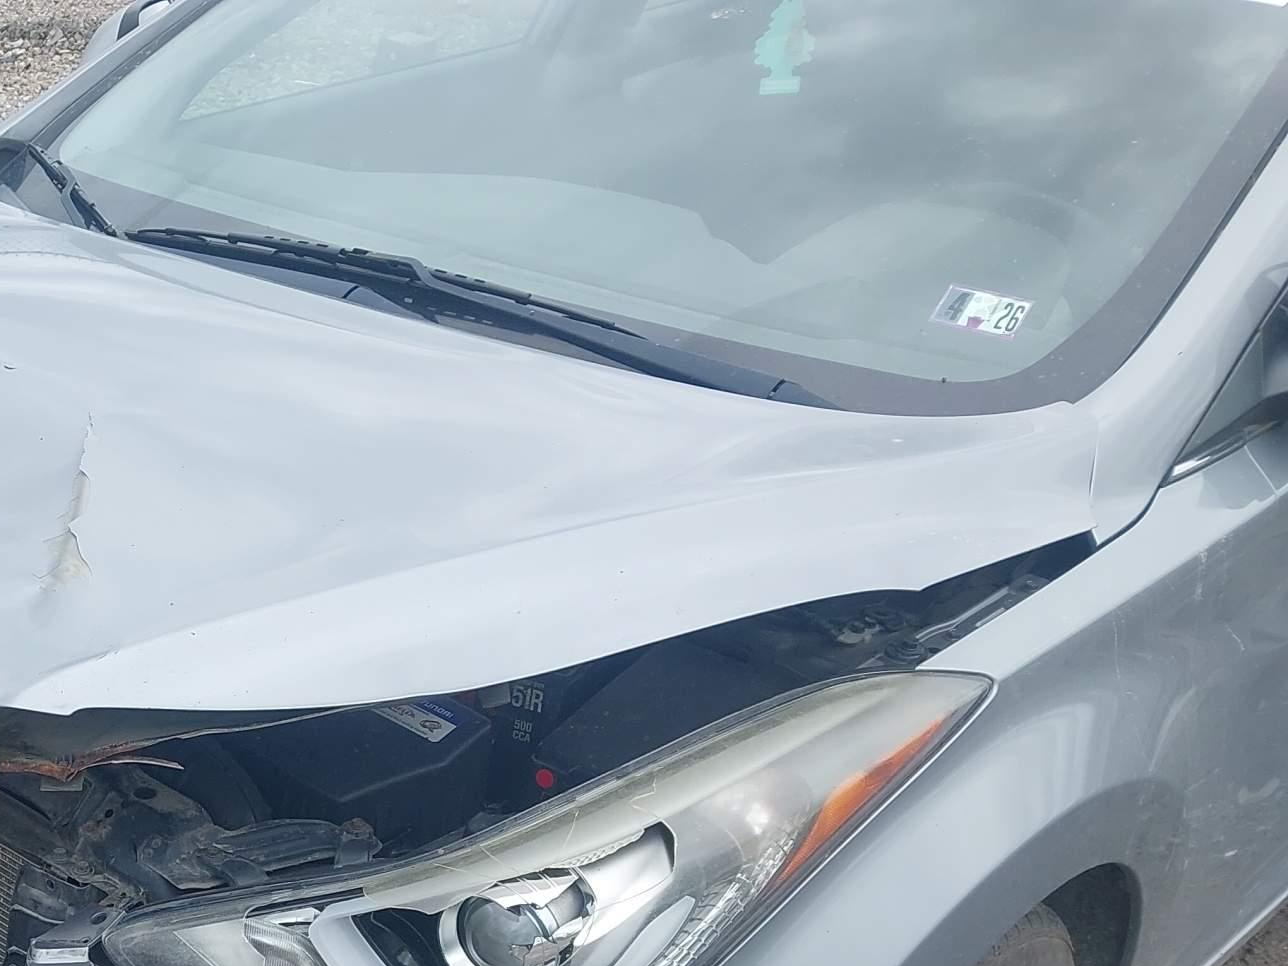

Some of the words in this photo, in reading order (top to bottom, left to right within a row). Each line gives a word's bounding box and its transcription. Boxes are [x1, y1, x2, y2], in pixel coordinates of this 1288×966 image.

[943, 292, 970, 321] 4
[993, 302, 1026, 332] 26
[511, 685, 544, 713] 51R
[512, 729, 531, 743] CCA
[513, 719, 533, 733] 500
